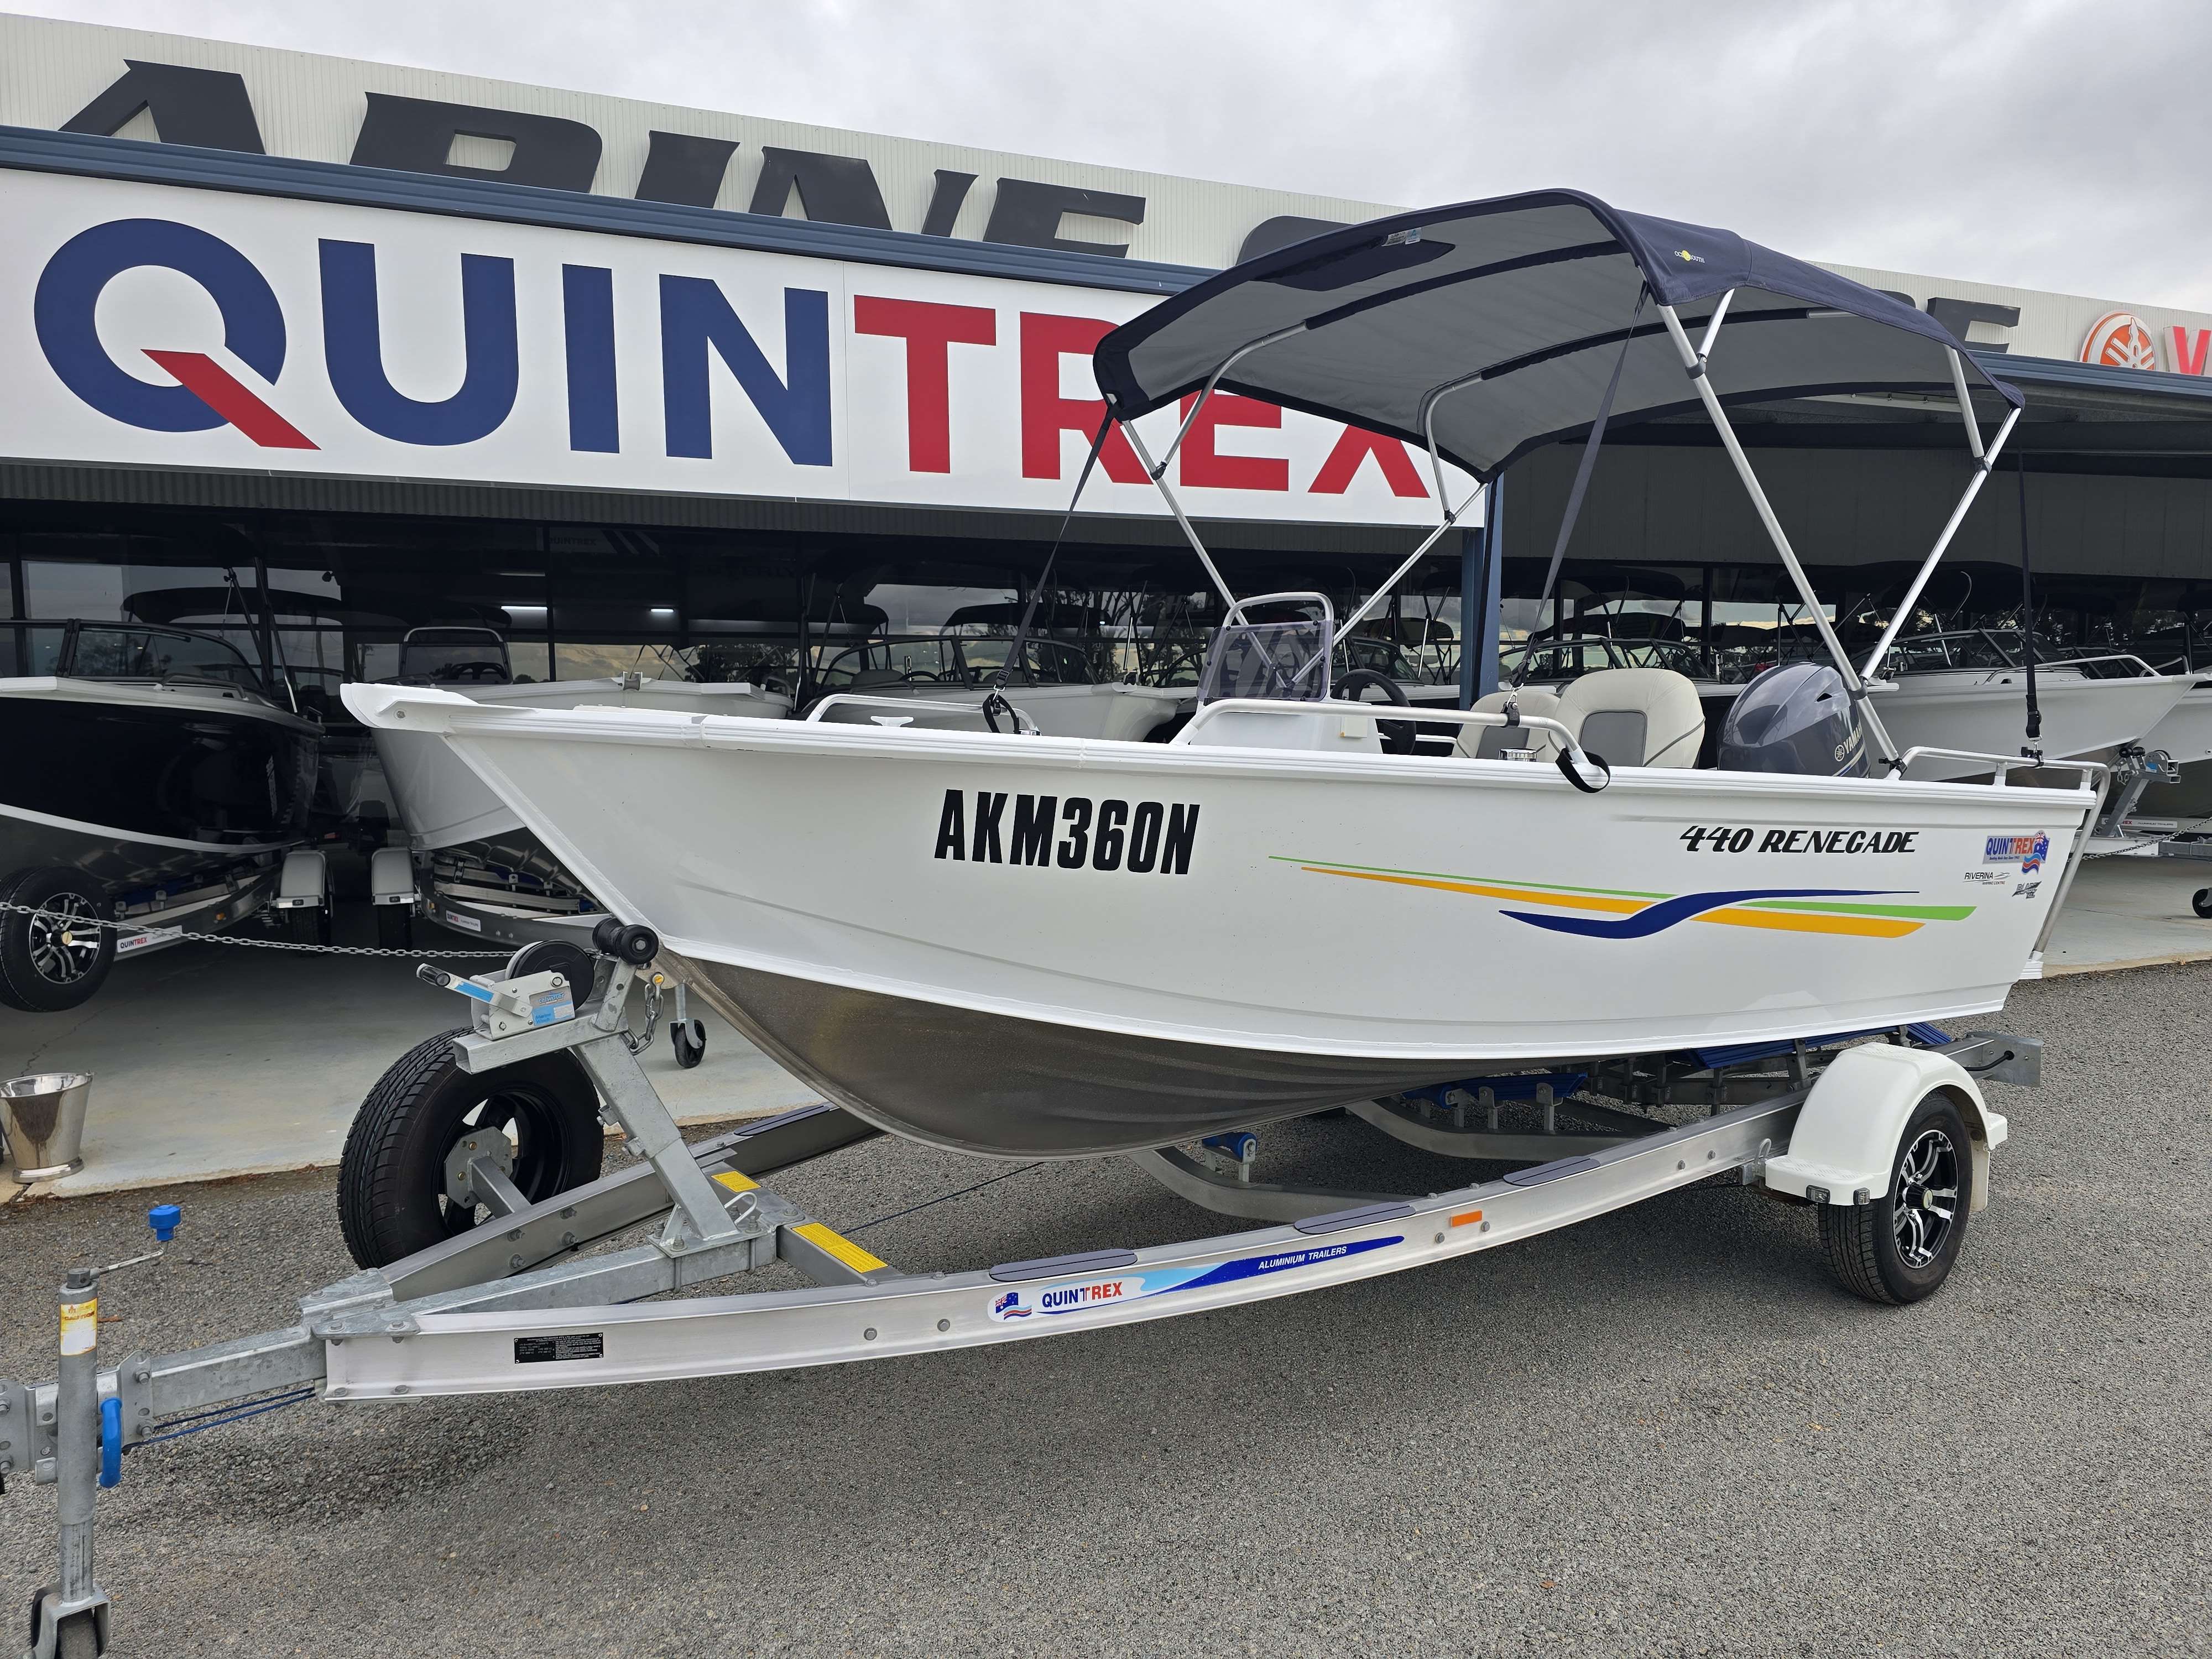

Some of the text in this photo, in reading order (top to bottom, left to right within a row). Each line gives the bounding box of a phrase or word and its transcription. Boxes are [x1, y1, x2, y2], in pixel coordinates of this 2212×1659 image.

[935, 789, 1200, 875] AKM360N
[1679, 826, 1919, 854] 440 RENEGADE
[1986, 837, 2036, 855] QUINTREX
[120, 937, 148, 949] QUINTREX
[538, 993, 565, 1004] telwater
[1042, 1246, 1347, 1308] QUINTREX ALUMINIUM TRAILERS
